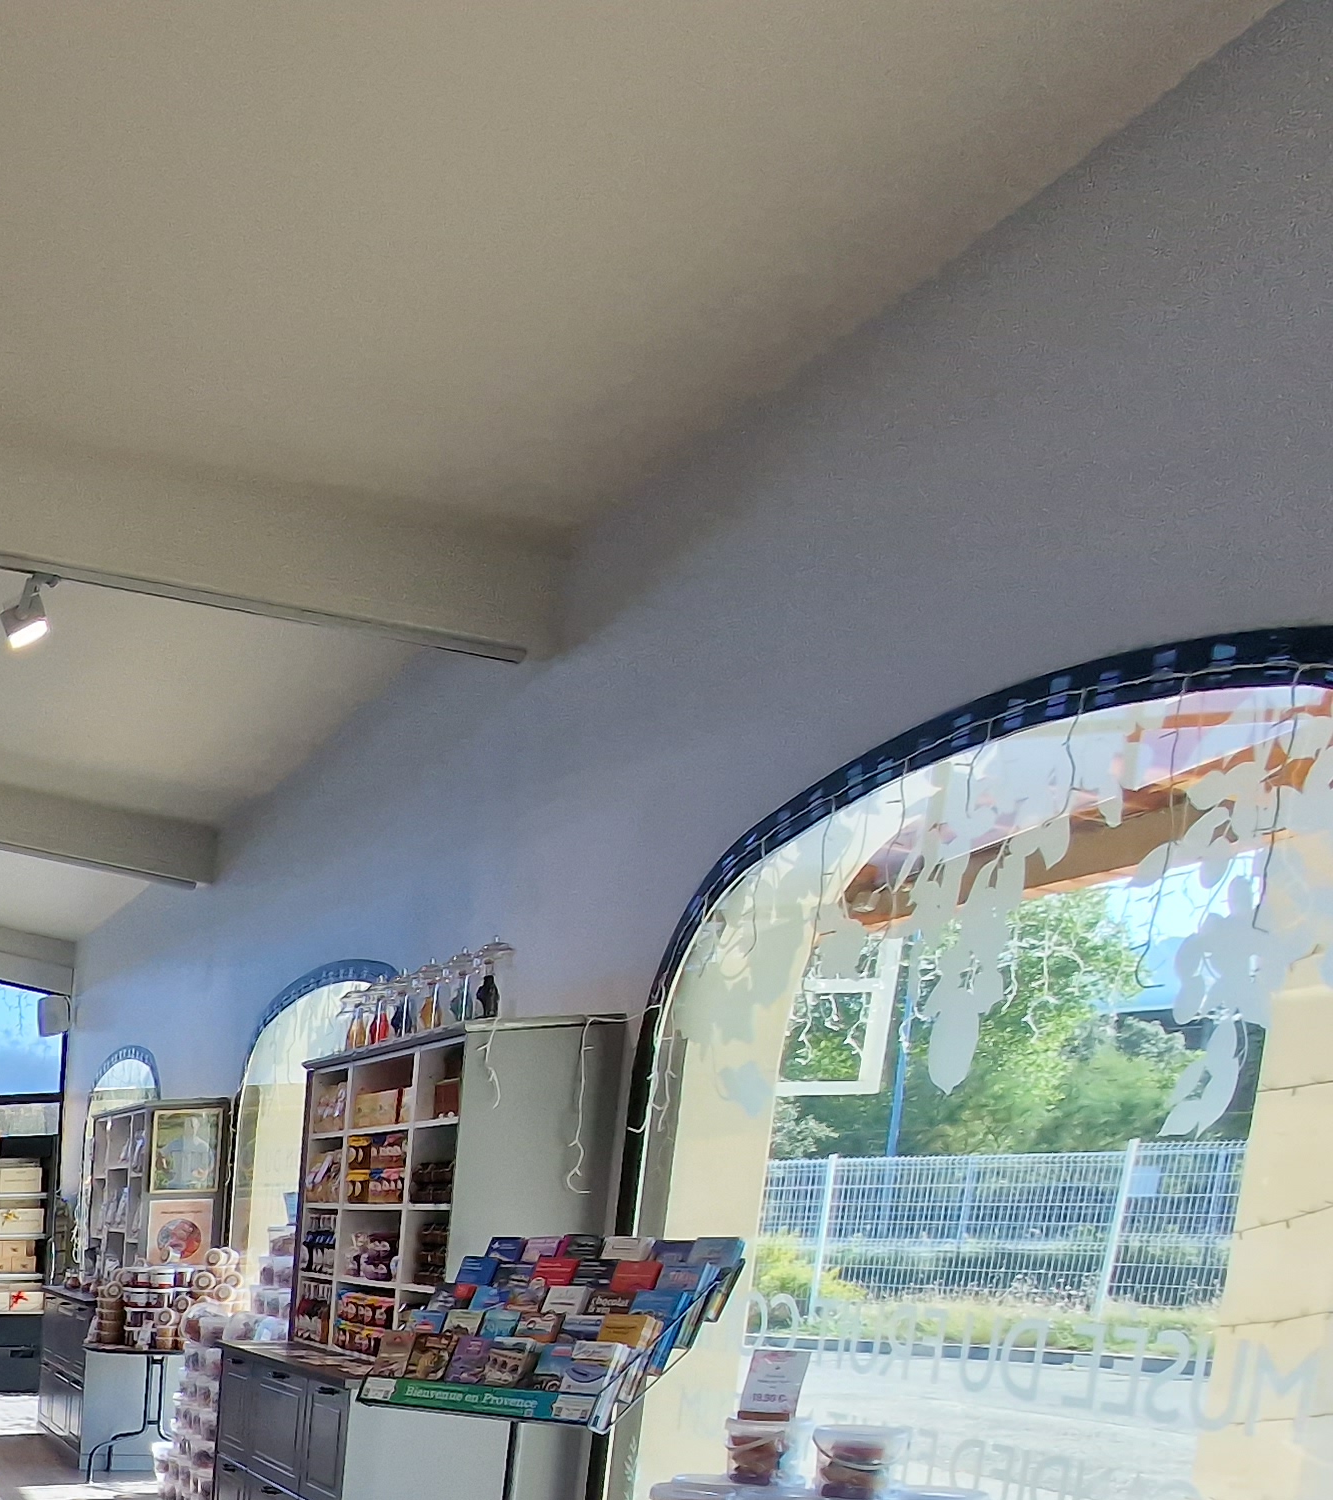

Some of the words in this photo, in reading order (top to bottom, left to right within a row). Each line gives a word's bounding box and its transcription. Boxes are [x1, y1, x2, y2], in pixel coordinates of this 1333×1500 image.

[404, 1386, 464, 1402] Bienvenue
[465, 1393, 479, 1402] en
[482, 1392, 538, 1409] Provence
